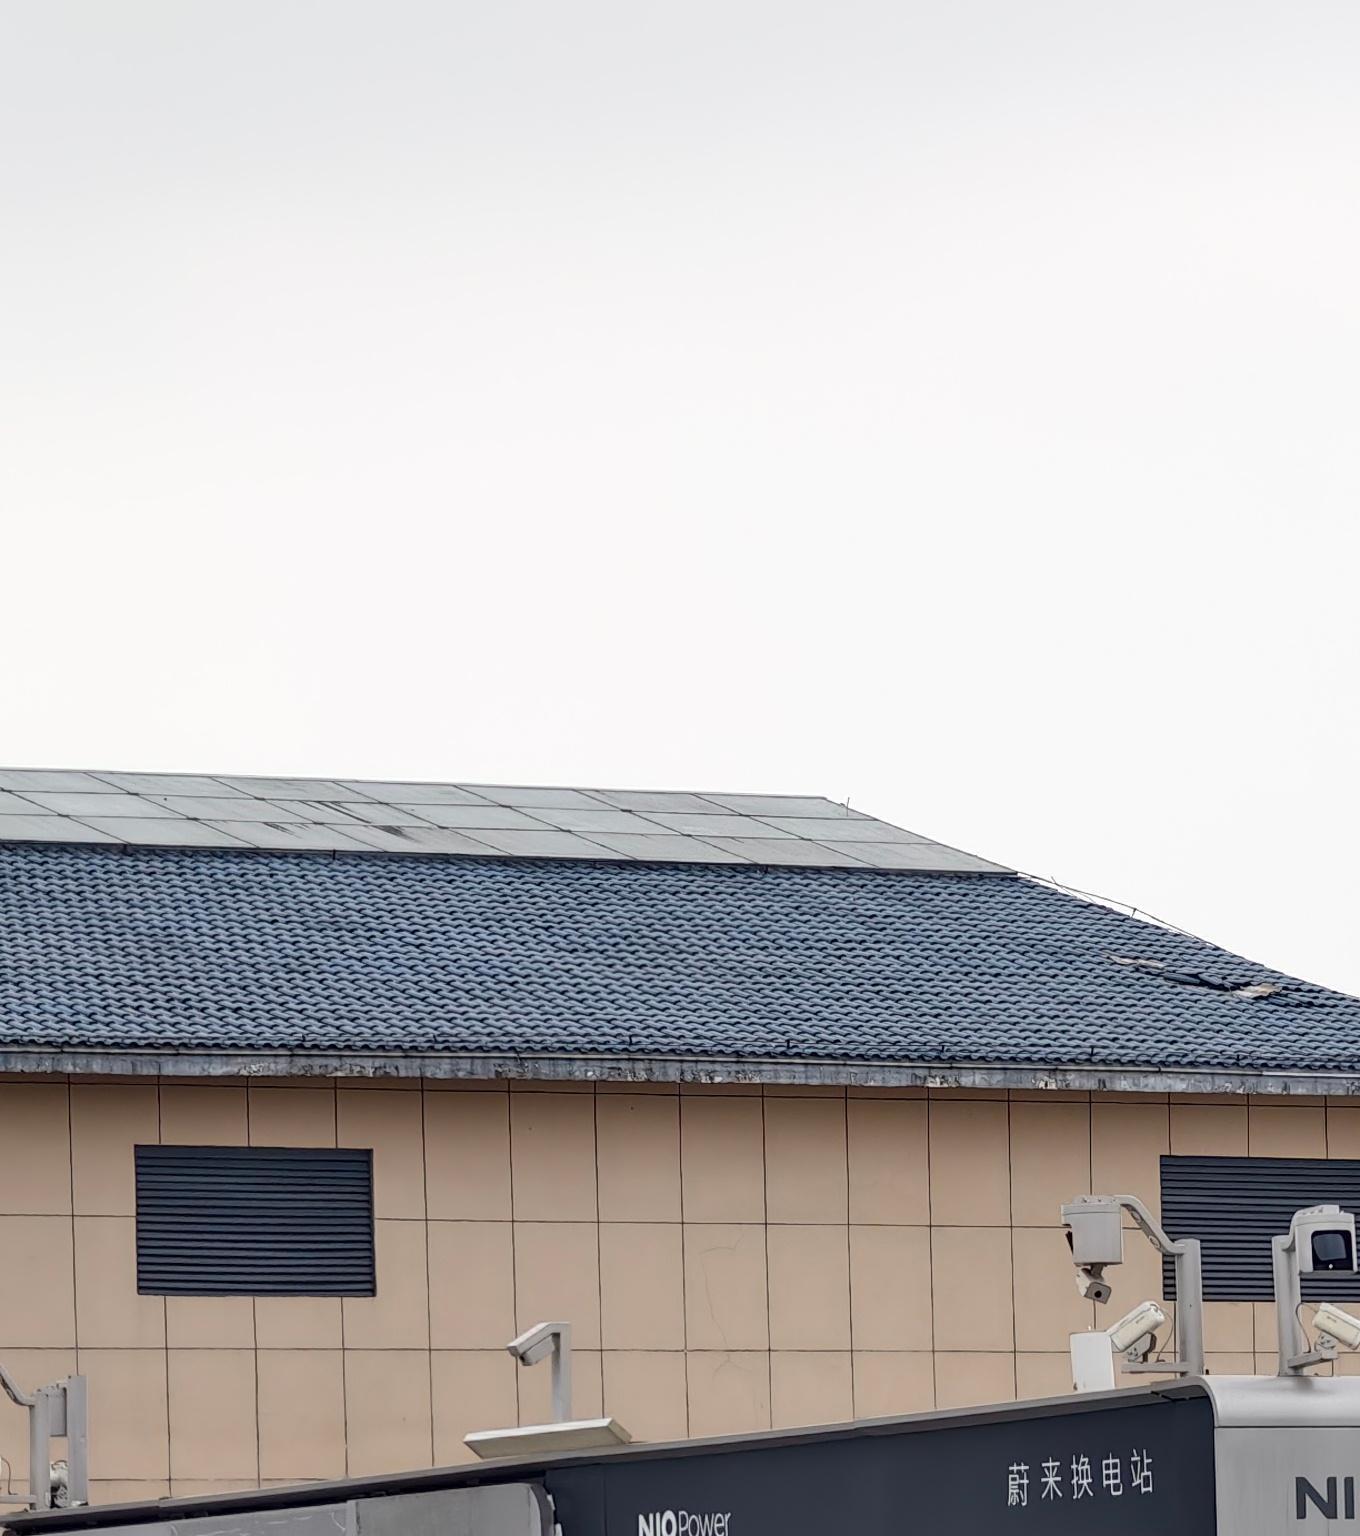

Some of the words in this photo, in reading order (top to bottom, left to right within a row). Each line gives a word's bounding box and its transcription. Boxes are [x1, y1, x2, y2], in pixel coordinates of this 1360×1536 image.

[1006, 1448, 1155, 1508] 蔚来换电站
